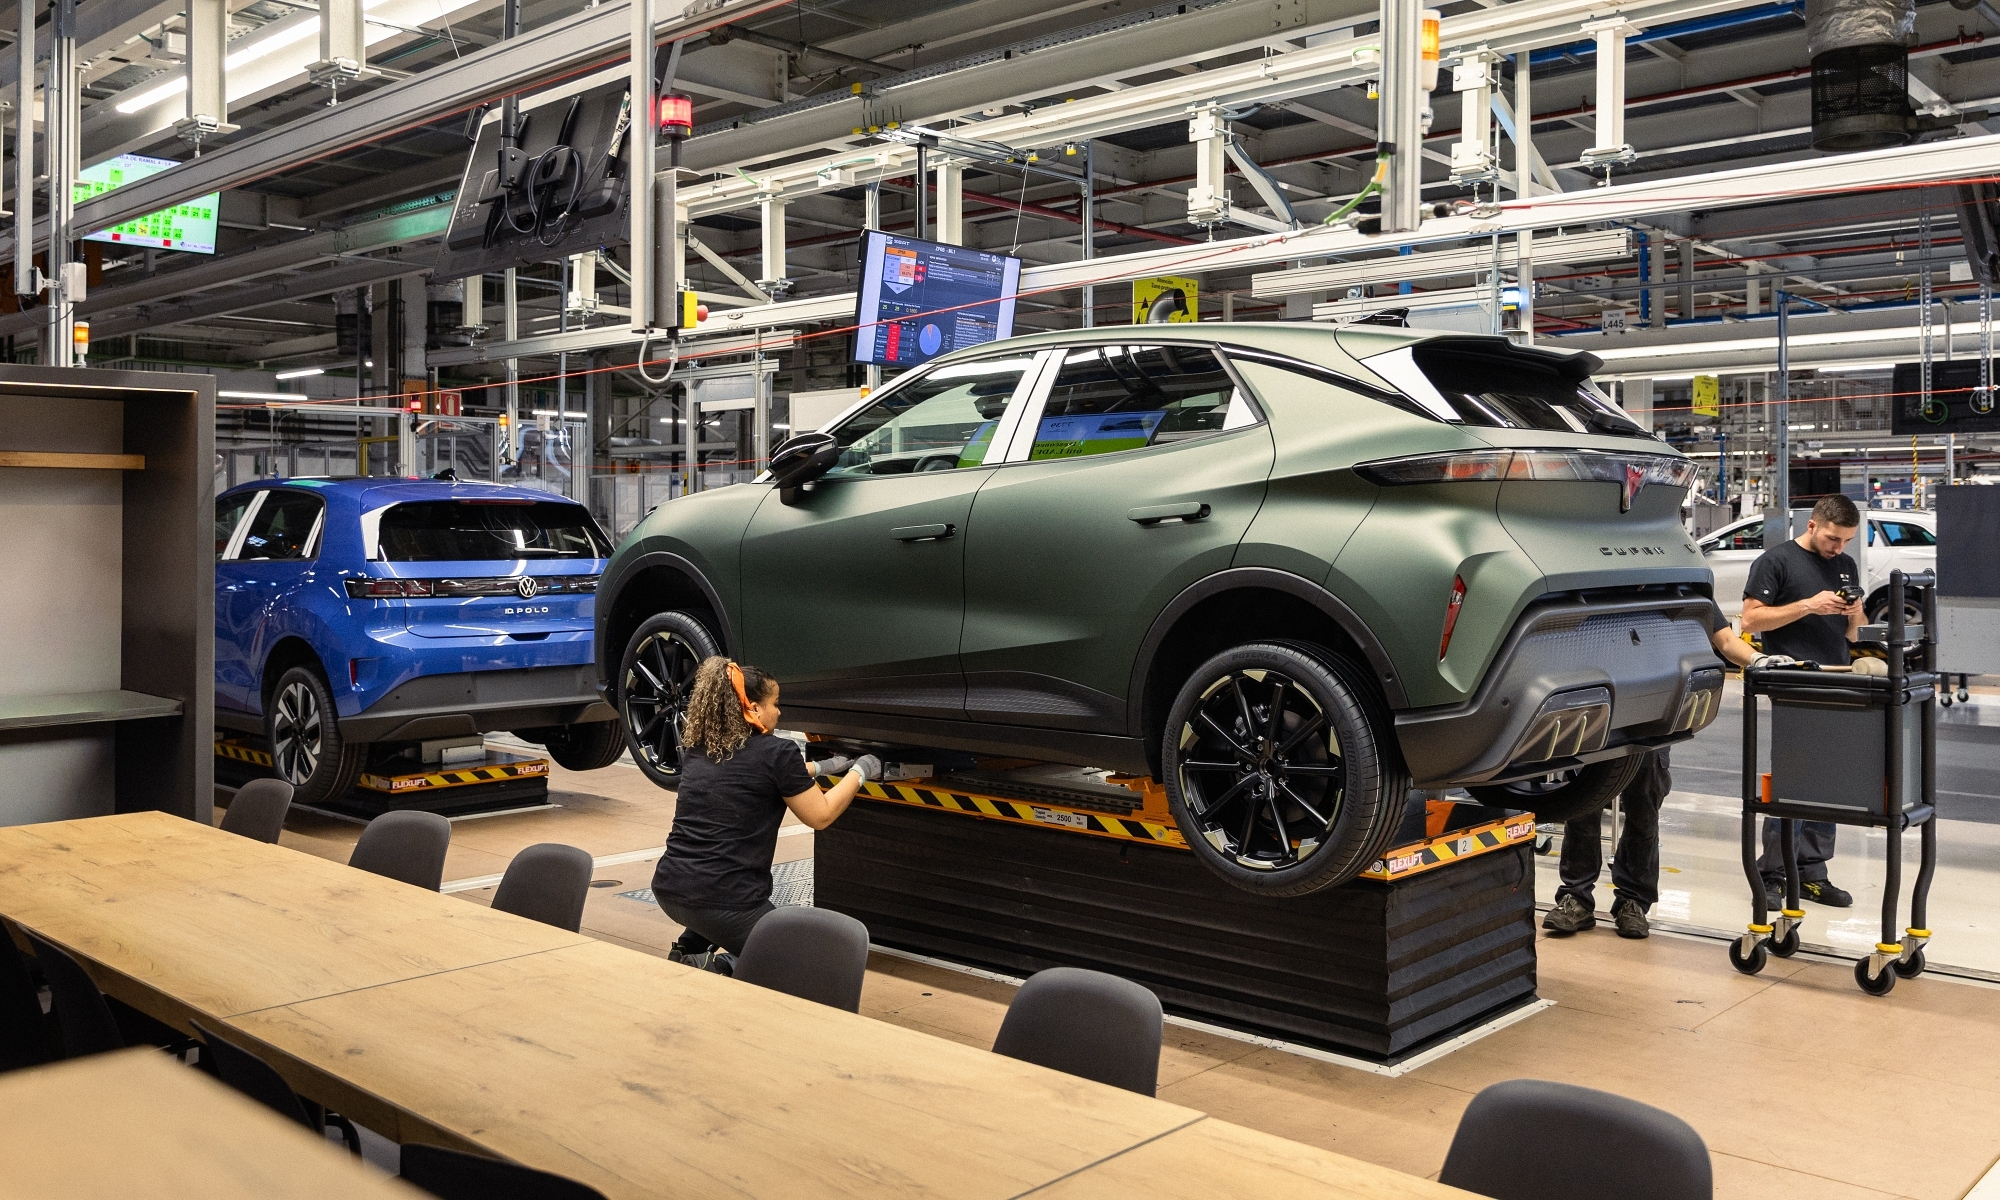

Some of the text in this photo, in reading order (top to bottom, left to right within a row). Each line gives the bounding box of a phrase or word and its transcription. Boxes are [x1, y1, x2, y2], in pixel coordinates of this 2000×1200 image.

[1603, 319, 1624, 329] L445
[1599, 546, 1666, 556] CUPRA
[516, 606, 549, 614] POLO
[1231, 651, 1278, 661] POTENZA
[517, 764, 549, 775] FLEXLIFT
[392, 778, 427, 790] FLEXLIFT
[1056, 814, 1072, 823] 2500
[1506, 821, 1534, 839] FLEXLIFT
[1462, 840, 1467, 852] 2
[1389, 852, 1423, 872] FLEXLIFT
